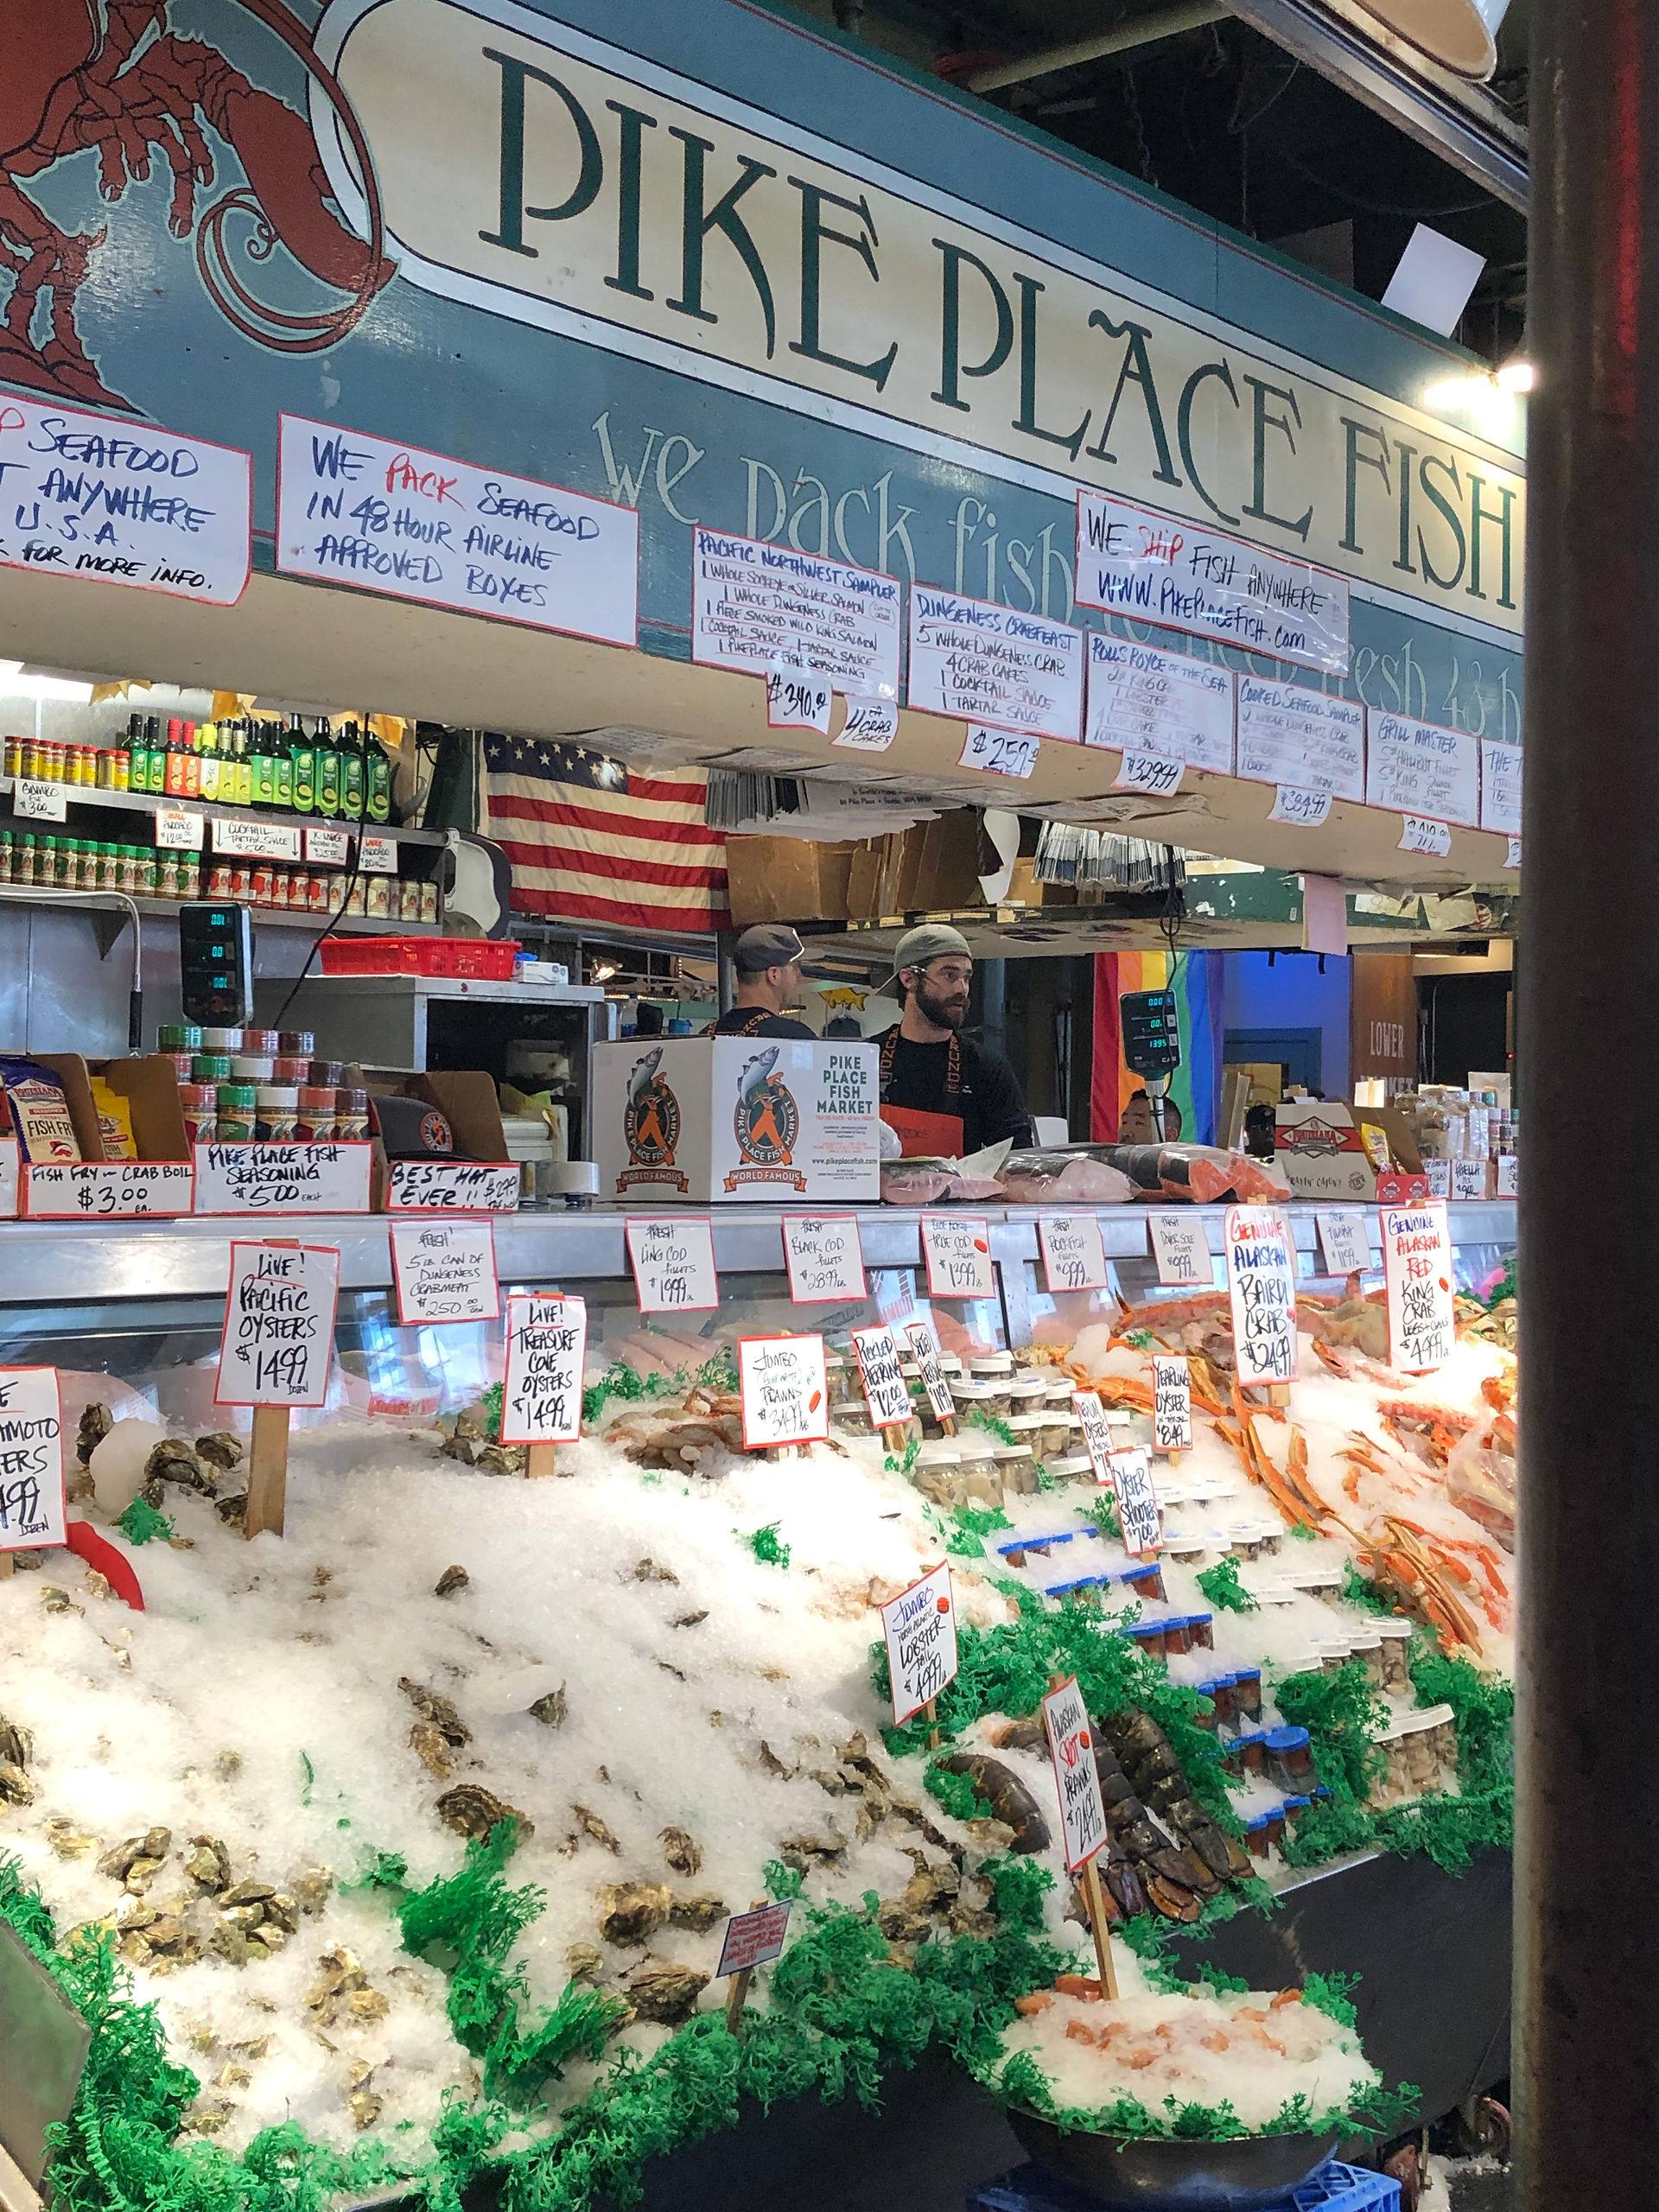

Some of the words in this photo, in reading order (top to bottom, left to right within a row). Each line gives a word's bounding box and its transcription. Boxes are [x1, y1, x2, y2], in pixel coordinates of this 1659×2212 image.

[478, 47, 898, 393] PIKE
[931, 238, 1313, 543] PLACE
[1338, 416, 1517, 610] FISH
[28, 417, 199, 478] SEAFOOD
[38, 467, 216, 532] ANYWHERE
[313, 434, 373, 482] WE
[385, 453, 466, 512] PACK
[476, 483, 600, 541] SEAFOOD
[15, 501, 135, 550] U.S.A.
[307, 491, 343, 520] IN
[350, 494, 389, 535] 48
[392, 511, 455, 554] HOUR
[463, 523, 562, 572] AIRLINE
[22, 539, 69, 566] FOR
[75, 553, 146, 576] MORE
[314, 535, 442, 583] APPROVED
[698, 531, 756, 563] PACIFIC
[761, 545, 843, 583] NORTHWEST
[843, 572, 899, 606] SAMPLER
[1087, 505, 1128, 555] WE
[1132, 525, 1184, 567] SHIP
[1190, 544, 1240, 586] FISH
[1248, 564, 1328, 615] ANYWHERE
[711, 563, 744, 582] WHOLE
[793, 582, 829, 604] SILVER
[830, 593, 864, 614] SALMON
[734, 587, 769, 606] WHOLE
[774, 598, 826, 620] DUNGENESS
[917, 594, 1001, 632] DUNGENESS
[744, 608, 786, 627] SMOKED
[790, 619, 813, 633] WILD
[837, 632, 878, 652] SALMON
[750, 628, 790, 646] SAUCE
[840, 651, 876, 666] SAUCE
[917, 625, 939, 643] 5
[935, 630, 974, 651] WHOLE
[973, 635, 1033, 667] DUNGENESS
[1034, 654, 1066, 677] CRAB
[807, 657, 866, 679] SEASONING
[957, 656, 990, 676] CRAB
[992, 664, 1029, 683] CAKES
[1092, 638, 1127, 662] ROLLS
[1129, 649, 1168, 673] ROYCE
[1201, 668, 1228, 693] SEA
[953, 673, 1012, 700] COCKTAIL
[1015, 685, 1057, 710] SAUCE
[1240, 678, 1281, 706] COOKED
[1282, 687, 1324, 715] SEAFOOD
[951, 697, 1001, 715] TARTAR
[1007, 705, 1044, 726] SAUCE
[851, 733, 891, 744] CAKES
[858, 719, 892, 733] CRAB
[1378, 715, 1410, 741] GRILL
[1414, 730, 1458, 759] MASTER
[1127, 754, 1179, 790] $329.99
[1485, 750, 1512, 772] THE
[1396, 770, 1417, 788] KING
[163, 811, 187, 820] SMALL
[228, 822, 275, 835] COCKTAIL
[264, 836, 289, 847] SAUCE
[1370, 1020, 1404, 1058] LOWER
[830, 1055, 861, 1070] PIKE
[823, 1070, 867, 1084] PLACE
[13, 1086, 64, 1098] LOUISIANA
[830, 1085, 861, 1099] FISH
[817, 1100, 873, 1114] MARKET
[27, 1120, 56, 1138] FISH
[630, 1139, 651, 1161] PLACE
[652, 1147, 669, 1161] FISH
[667, 1100, 677, 1146] MARKET
[737, 1108, 746, 1136] PIKE
[785, 1100, 796, 1147] MARKET
[207, 1143, 245, 1170] PIKE
[250, 1143, 301, 1165] PLACE
[304, 1147, 346, 1164] FISH
[741, 1139, 766, 1161] PLACE
[767, 1146, 785, 1161] FISH
[811, 1157, 878, 1166] www.pikeplacefish.com
[32, 1166, 63, 1182] FISH
[71, 1166, 100, 1181] FRY
[122, 1166, 159, 1180] CRAB
[163, 1166, 194, 1179] BOIL
[226, 1164, 320, 1185] SEASONING
[391, 1162, 458, 1186] BEST
[454, 1167, 499, 1185] HAT
[622, 1171, 648, 1182] WORLD
[650, 1171, 683, 1182] FAMOUS
[732, 1171, 764, 1181] WORLD
[765, 1172, 800, 1182] FAMOUS
[77, 1186, 149, 1214] $3.00
[1230, 1209, 1285, 1243] GENUINE
[1388, 1211, 1434, 1236] GENUINE
[791, 1236, 822, 1255] BLACK
[825, 1237, 845, 1251] COD
[928, 1234, 953, 1249] TRUE
[954, 1236, 971, 1249] COD
[1047, 1235, 1087, 1252] ROCKFISH
[1179, 1233, 1195, 1244] SOLE
[441, 1253, 466, 1264] CAN
[469, 1253, 484, 1264] OF
[641, 1244, 664, 1263] LING
[665, 1246, 688, 1262] COD
[815, 1255, 843, 1268] FILLETS
[1233, 1244, 1287, 1271] ALASKAN
[420, 1268, 481, 1281] DUNGENESS
[663, 1264, 696, 1275] FILLETS
[1406, 1256, 1433, 1281] RED
[239, 1274, 309, 1312] PACIFIC
[410, 1281, 480, 1296] CRABMEAT
[1237, 1274, 1289, 1312] BAIRDI
[1402, 1280, 1434, 1307] KING
[1245, 1306, 1288, 1339] CRAB
[1402, 1300, 1435, 1325] CRAB
[238, 1313, 319, 1344] OYSTERS
[508, 1327, 581, 1354] TREASURE
[529, 1351, 559, 1373] COVE
[752, 1347, 798, 1370] JUMBO
[855, 1337, 893, 1363] PICKLED
[522, 1371, 573, 1399] OYSTERS
[864, 1358, 902, 1389] HERRING
[1154, 1361, 1190, 1387] YEARLING
[760, 1386, 803, 1407] PRAWNS
[1154, 1391, 1190, 1415] OYSTER
[1111, 1466, 1149, 1501] OYSTER
[1120, 1497, 1157, 1528] SHOOTER
[892, 1586, 934, 1632] JUMBO
[899, 1614, 946, 1669] LOBSTER
[907, 1649, 936, 1675] TAIL
[1049, 1695, 1082, 1743] ALASKAN
[1058, 1732, 1080, 1776] SPOT
[1063, 1756, 1091, 1807] PRAWNS
